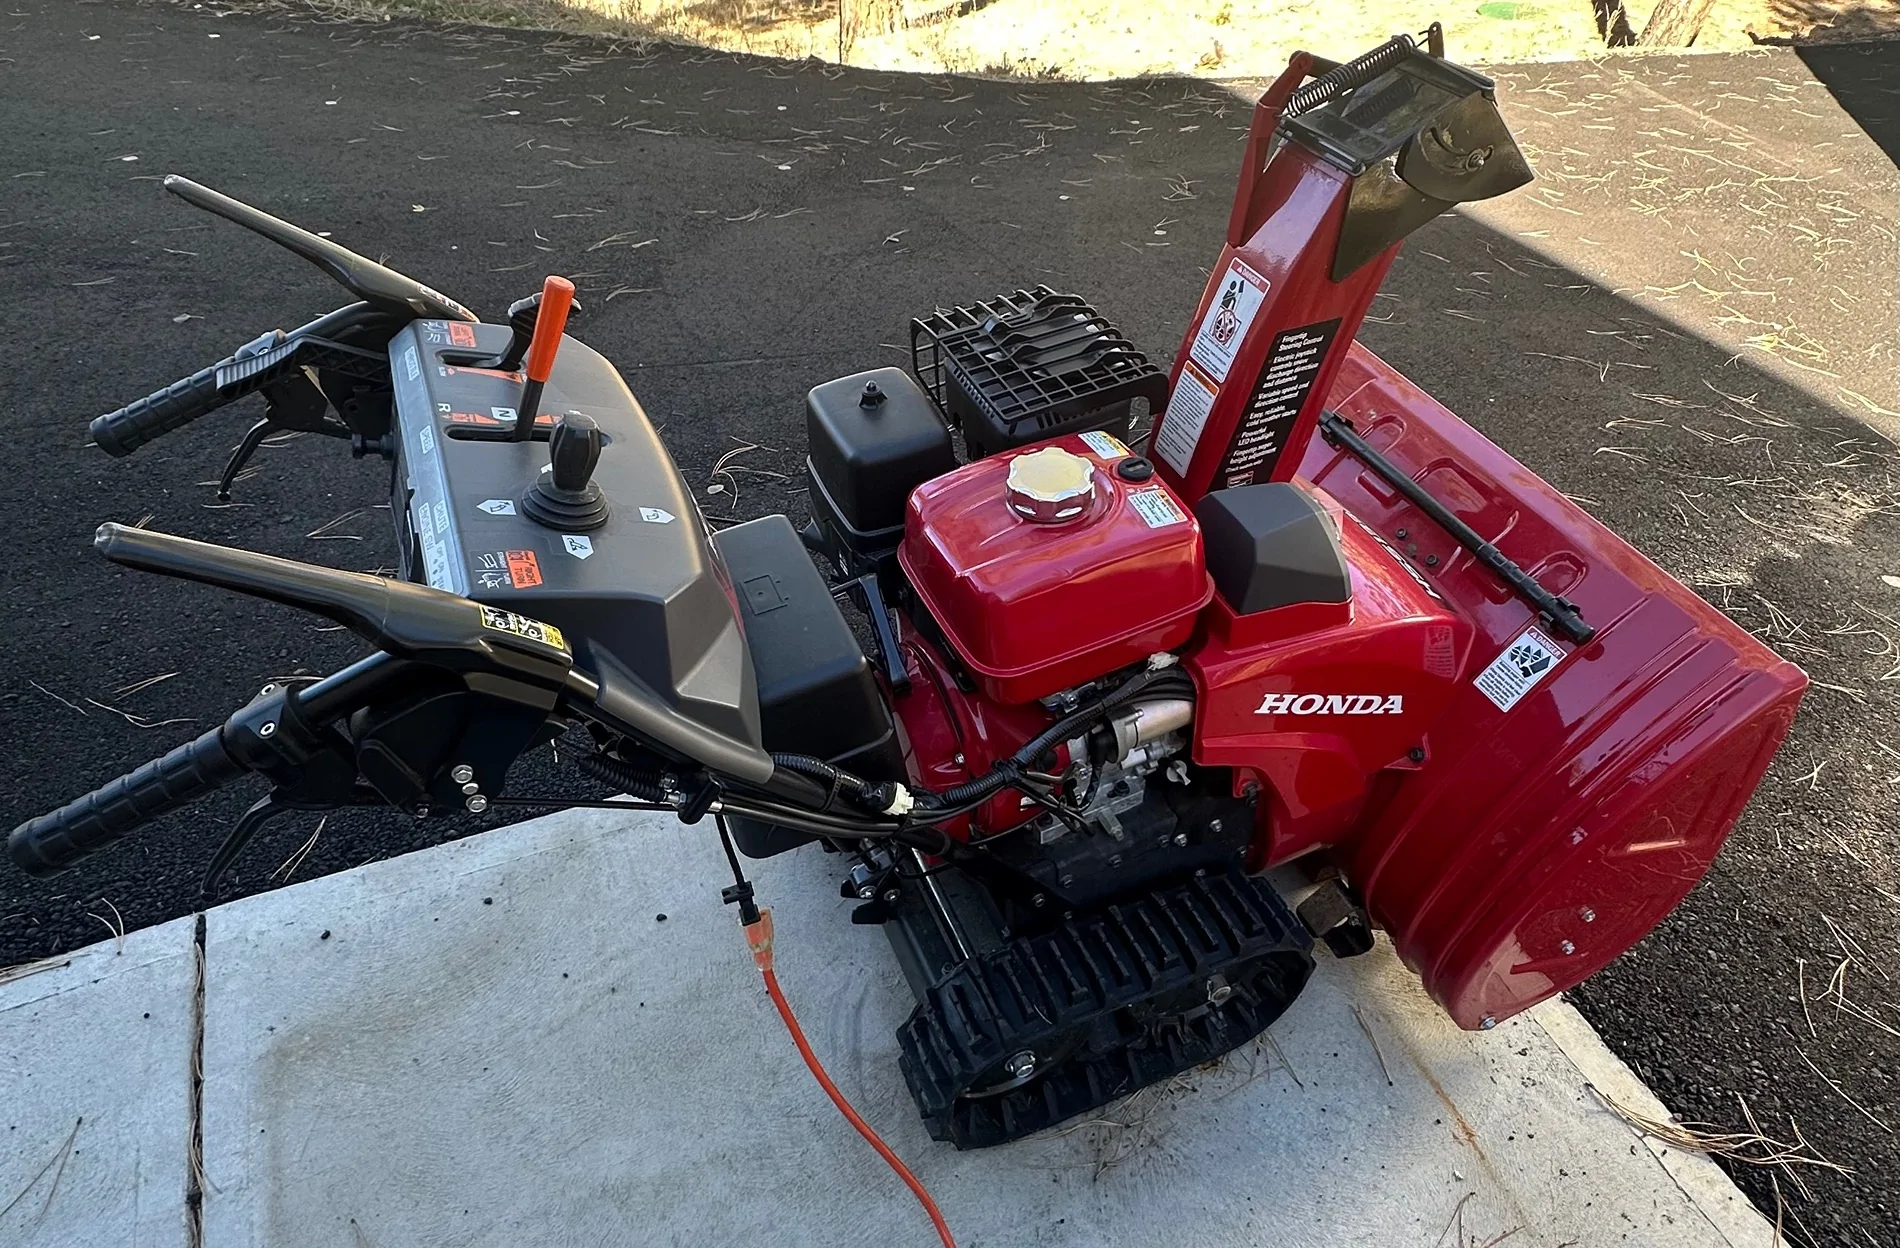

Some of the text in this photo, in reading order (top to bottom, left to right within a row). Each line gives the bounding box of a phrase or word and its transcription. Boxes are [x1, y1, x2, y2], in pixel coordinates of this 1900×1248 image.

[1278, 335, 1324, 351] Steering Control
[1282, 332, 1308, 343] Fingertip
[1273, 347, 1317, 364] Electric joystick
[1266, 363, 1319, 380] discharge direction
[1270, 358, 1309, 372] controls snow
[1258, 381, 1310, 399] Variable speed and
[1262, 375, 1298, 388] and distance
[438, 403, 451, 412] R
[1254, 391, 1299, 408] direction control
[498, 409, 511, 418] N
[1246, 409, 1297, 427] cold weather starts
[421, 427, 433, 452] SPEED
[1238, 431, 1275, 446] LED headlight
[1241, 426, 1267, 438] Powerful
[420, 504, 431, 537] ENGINE
[435, 501, 447, 531] CHUTE
[514, 567, 525, 584] TURN
[525, 567, 537, 585] RIGHT
[1536, 635, 1562, 657] DANGER
[1254, 694, 1404, 715] HONDA
